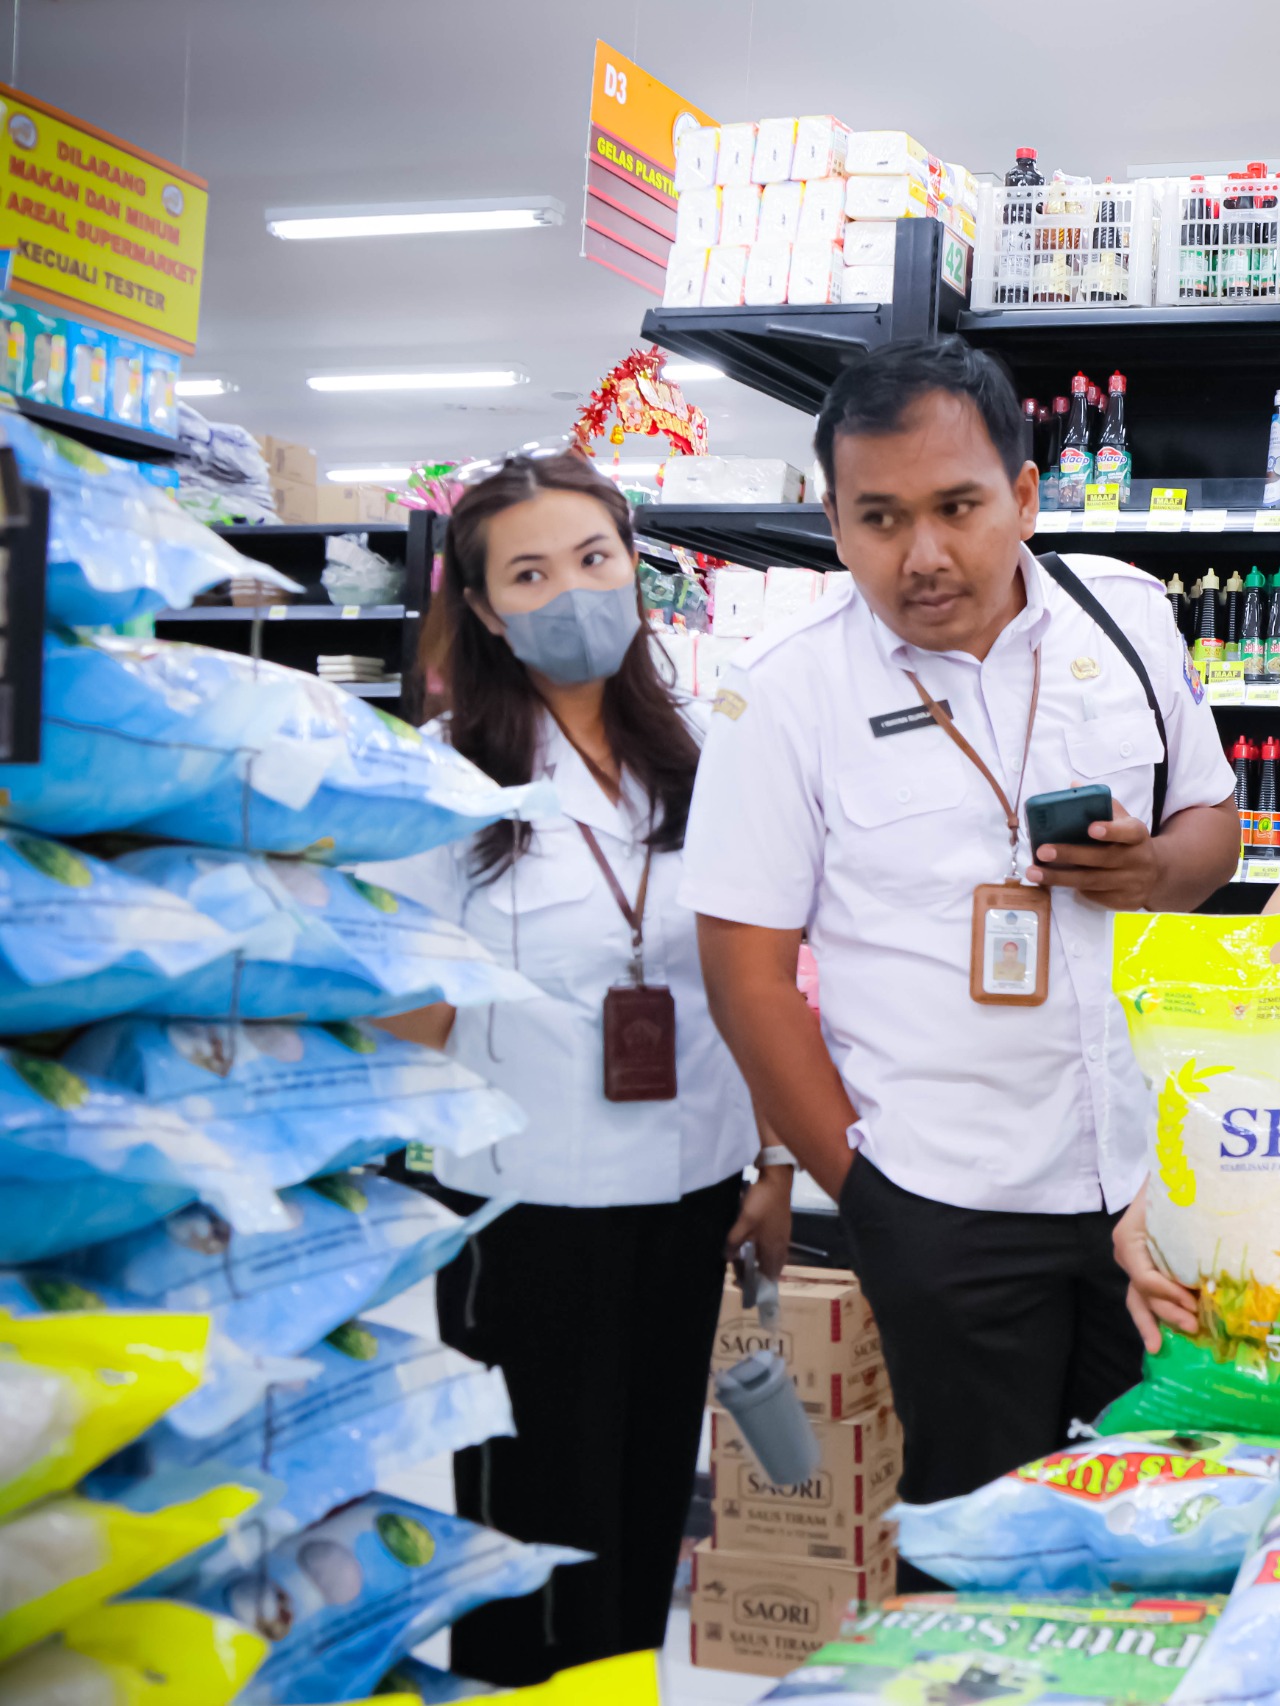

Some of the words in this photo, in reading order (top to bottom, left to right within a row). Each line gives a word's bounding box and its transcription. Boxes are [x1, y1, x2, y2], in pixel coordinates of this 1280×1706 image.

[604, 63, 628, 105] D3
[57, 140, 146, 196] DILARANG
[597, 136, 633, 172] GELAS
[9, 155, 79, 202] MAKAN
[85, 188, 121, 219] DAN
[126, 206, 180, 246] MINUM
[7, 192, 70, 233] AREAL
[76, 220, 197, 286] SUPERMARKET
[17, 237, 97, 285] KECUALI
[104, 270, 166, 312] TESTER
[945, 241, 966, 283] 42
[1214, 670, 1238, 678] MAAF
[748, 1509, 781, 1522] SAUS
[785, 1511, 828, 1526] TIRAM
[742, 1602, 810, 1626] SAORI
[730, 1631, 770, 1648] SAUS
[1027, 1620, 1208, 1669] Putri
